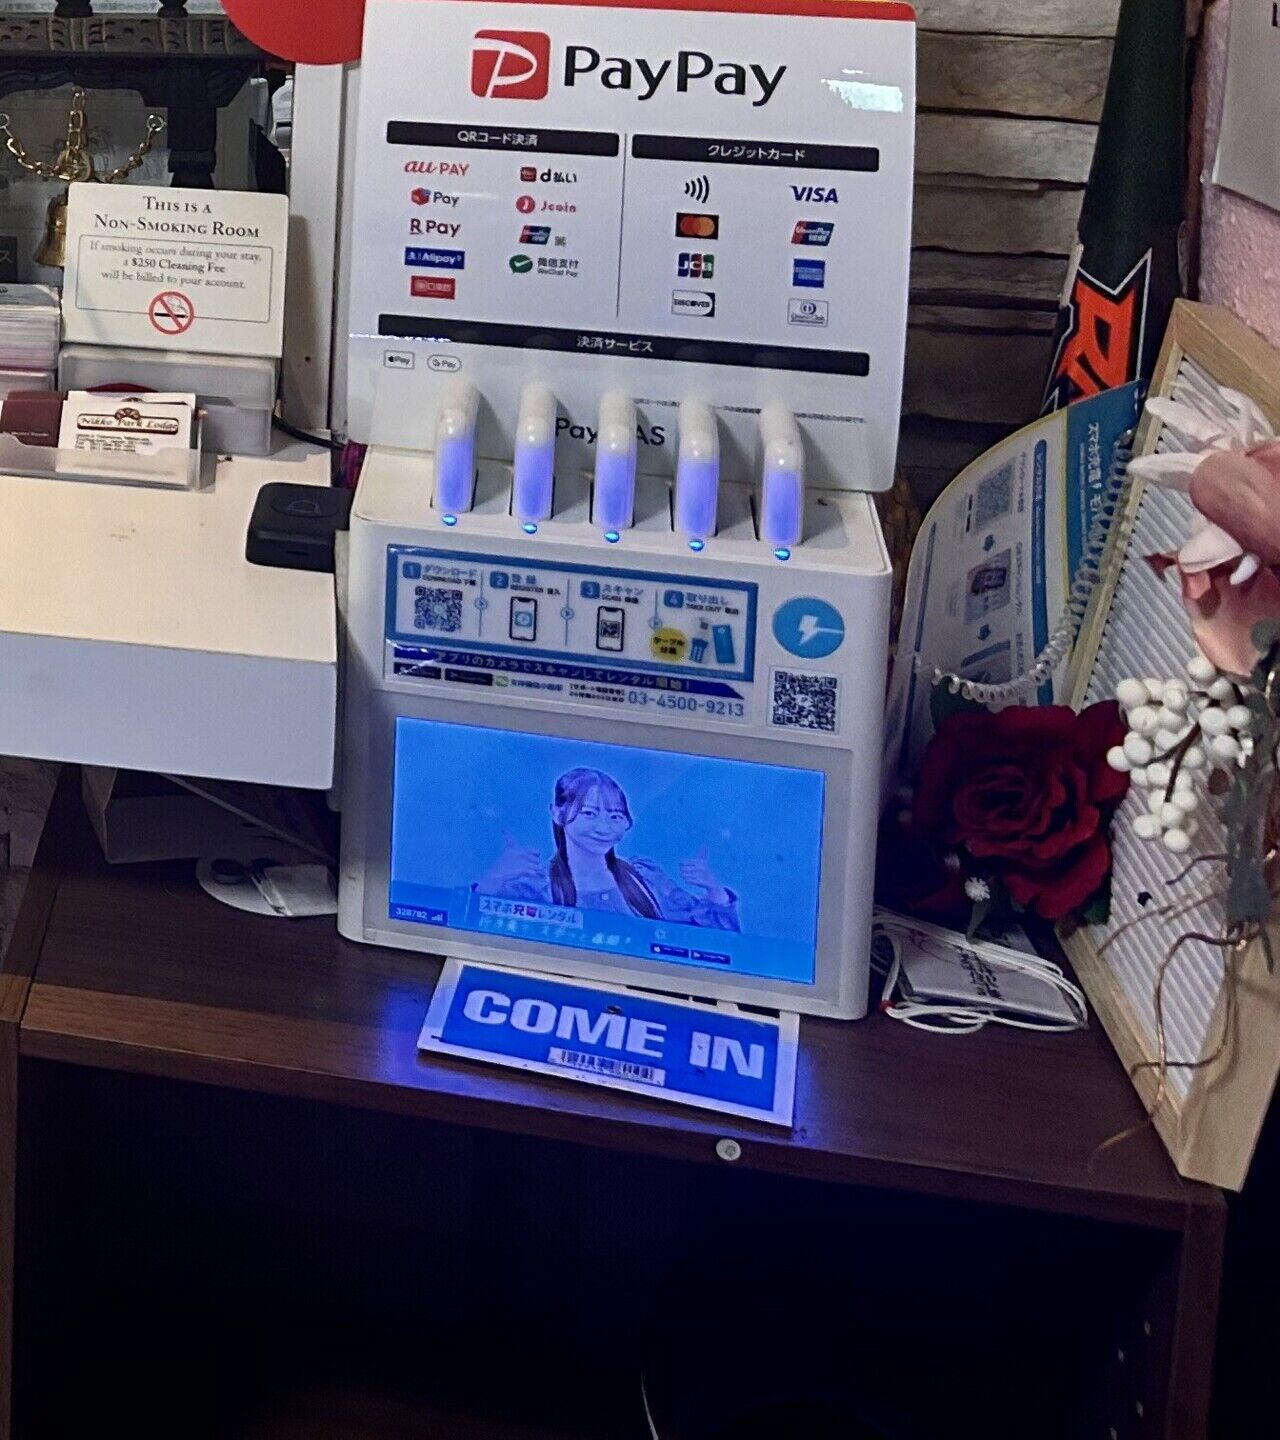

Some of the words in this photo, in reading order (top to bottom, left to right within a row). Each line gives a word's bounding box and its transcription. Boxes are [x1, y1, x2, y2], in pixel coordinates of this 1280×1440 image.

[563, 44, 787, 107] PayPay
[456, 129, 540, 147] QRコード決済
[707, 144, 806, 162] クレジットカード
[404, 161, 438, 174] au
[439, 162, 470, 176] PAY
[433, 191, 460, 208] Pay
[790, 184, 839, 204] VISA
[94, 213, 208, 236] NON-SMOKING
[212, 222, 260, 238] ROOM
[425, 219, 461, 238] Pay
[101, 242, 142, 257] smoking
[145, 246, 177, 256] occurs
[179, 246, 212, 259] during
[215, 250, 237, 262] your
[132, 258, 156, 269] $250
[158, 258, 204, 274] Cleaning
[207, 261, 225, 273] Fee
[101, 269, 119, 280] will
[122, 270, 133, 281] be
[136, 271, 164, 284] billed
[167, 275, 177, 284] to
[179, 277, 202, 288] your
[576, 335, 654, 354] 決済サービス
[628, 690, 745, 717] 03-4500-9213
[462, 987, 668, 1059] COME
[689, 1031, 766, 1081] IN
